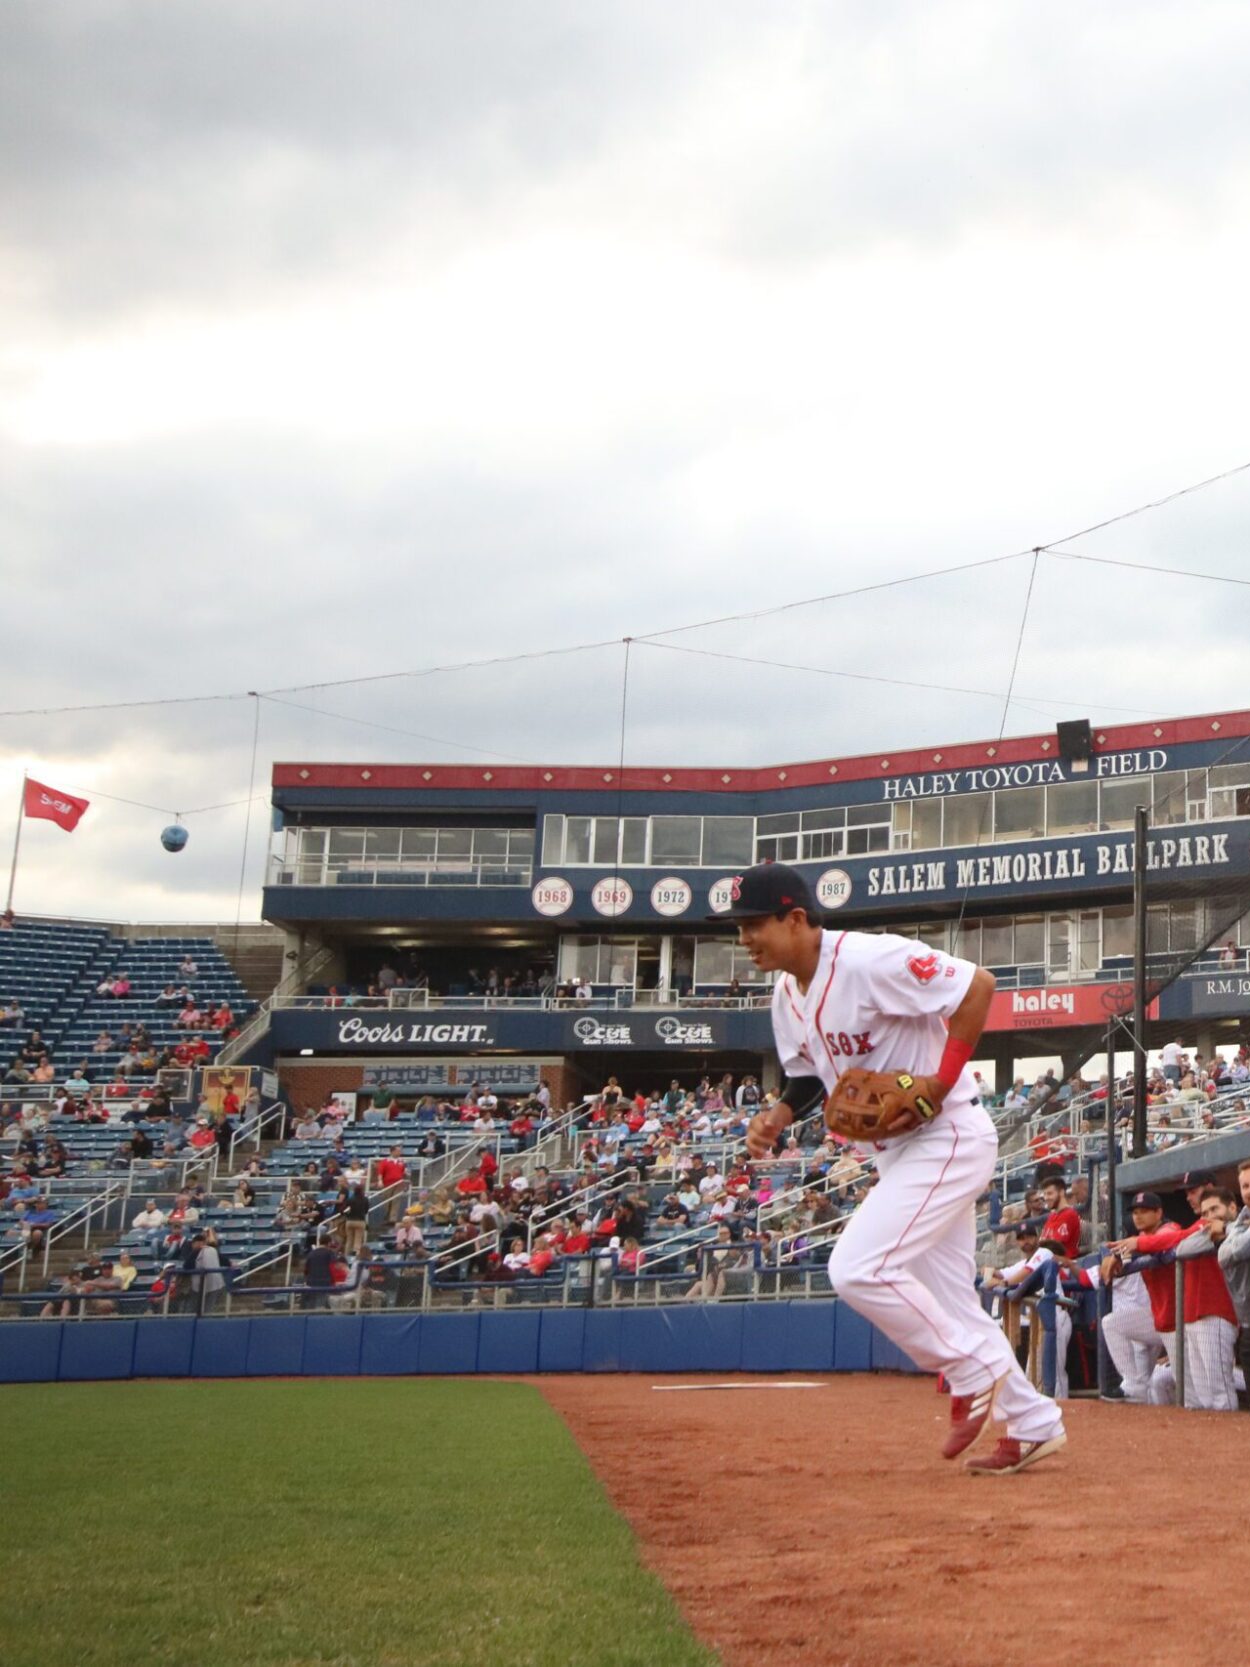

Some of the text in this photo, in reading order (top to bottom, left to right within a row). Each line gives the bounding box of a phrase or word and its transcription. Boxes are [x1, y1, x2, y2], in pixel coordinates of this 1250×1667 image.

[882, 750, 1168, 800] HALEY TOYOTA FIELD
[868, 861, 946, 896] SALEM
[956, 848, 1086, 888] MEMORIAL
[537, 890, 568, 903] 1968
[598, 890, 627, 903] 1969
[657, 891, 685, 903] 1972
[822, 883, 846, 896] 1987
[1207, 979, 1235, 995] R.M.
[1012, 990, 1074, 1014] haley
[338, 1017, 405, 1043] Coors
[1013, 1017, 1053, 1028] TOYOTA
[826, 1031, 876, 1057] SOX
